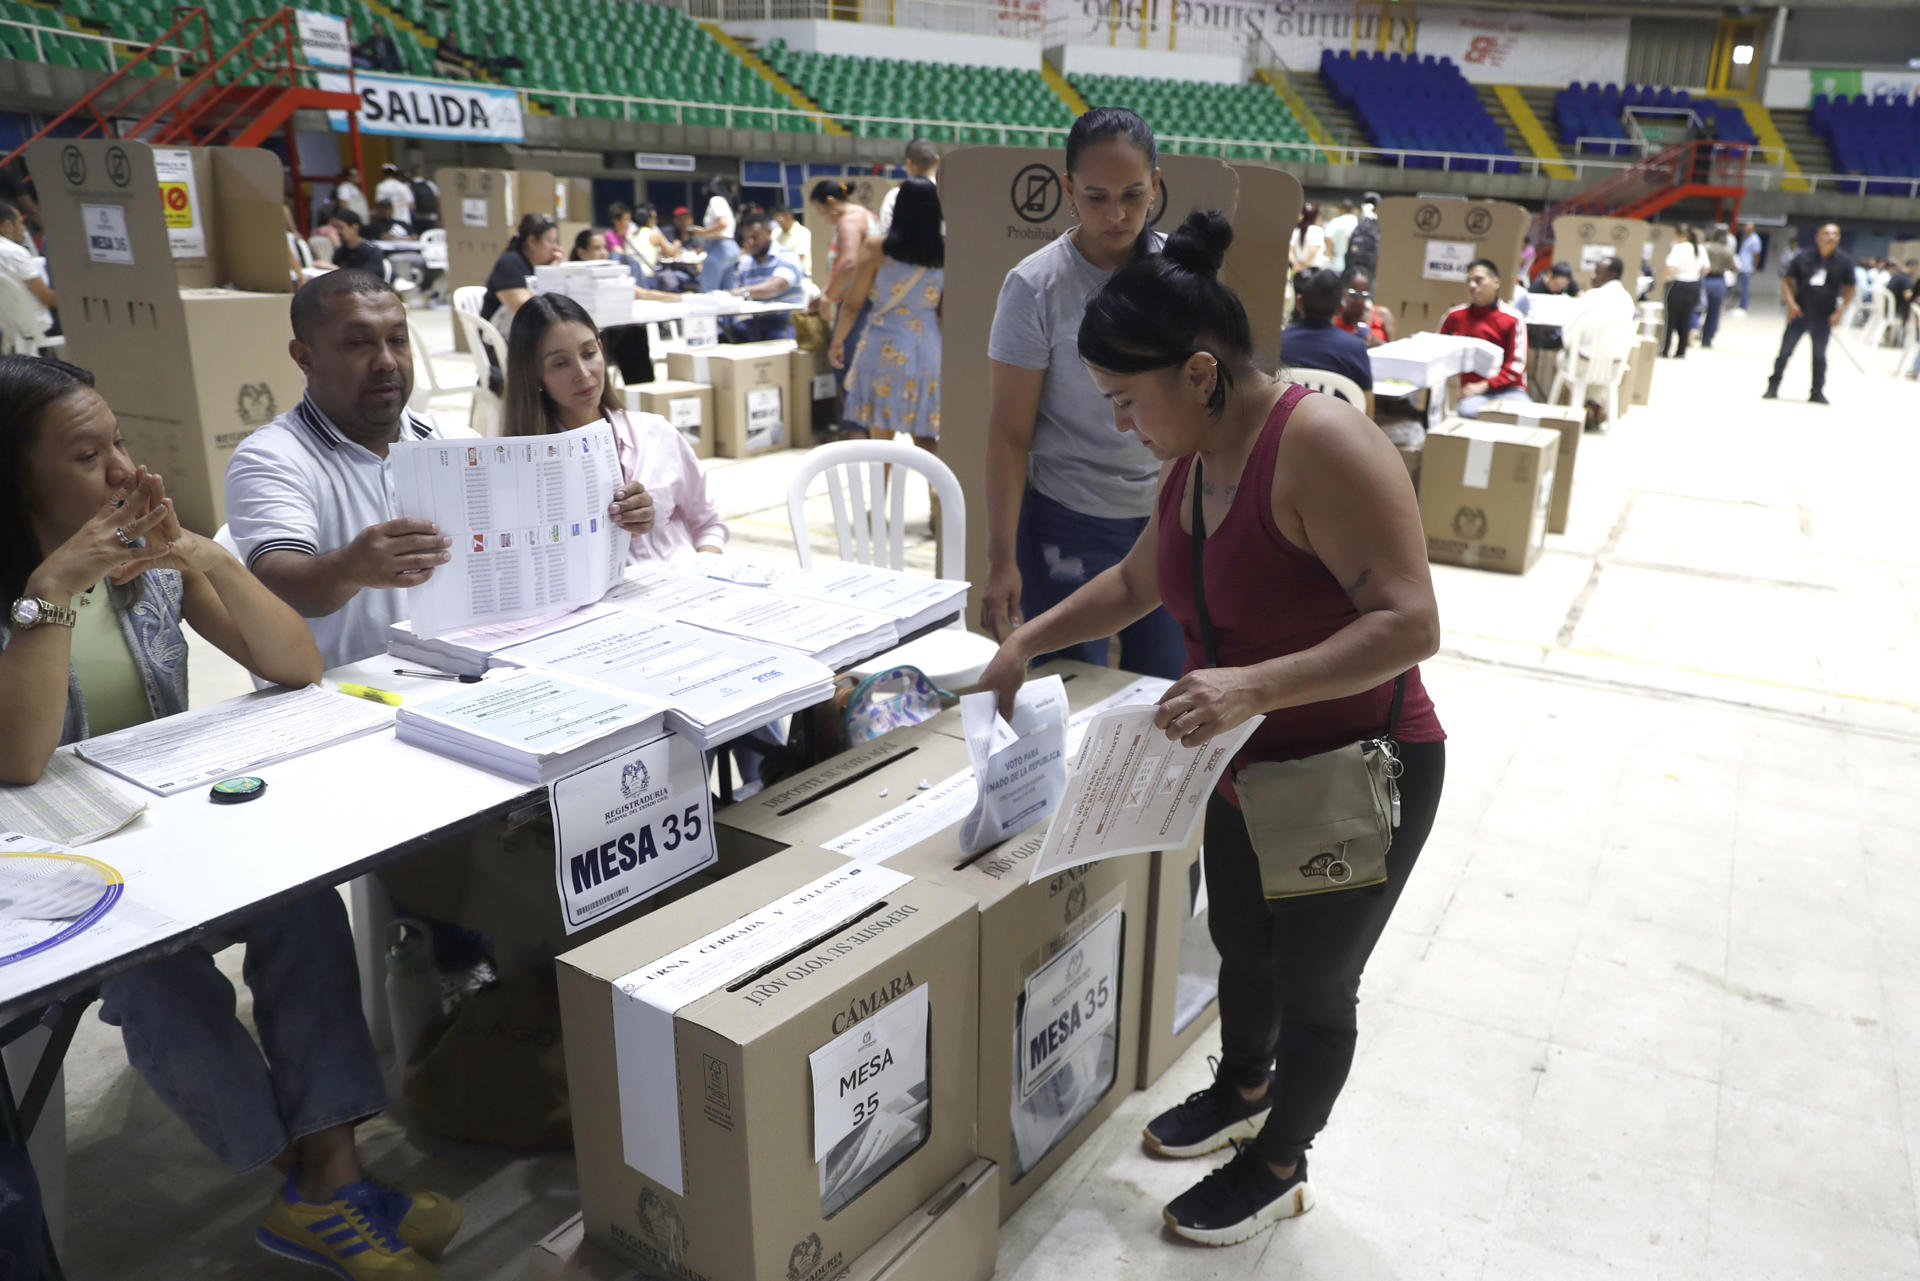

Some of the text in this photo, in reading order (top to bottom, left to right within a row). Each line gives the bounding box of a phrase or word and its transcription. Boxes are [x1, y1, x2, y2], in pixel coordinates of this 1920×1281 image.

[360, 88, 489, 129] SALIDA
[1007, 226, 1062, 240] Prohibid
[761, 773, 826, 809] DEPOSITE
[823, 765, 841, 780] SU
[839, 752, 870, 770] VOTO
[1005, 748, 1039, 772] VOTO PARA
[1010, 771, 1019, 783] DE
[1020, 767, 1028, 777] LA
[1077, 768, 1100, 817] VOTO PARA
[865, 811, 913, 836] CERRADA
[570, 803, 702, 895] MESA 35
[646, 959, 690, 980] URNA
[700, 921, 766, 954] CERRADA
[792, 876, 849, 906] SELLADA
[744, 904, 919, 1007] DEPOSITE SU VOTO AQUÍ
[832, 970, 915, 1035] CÁMARA
[1030, 998, 1082, 1072] MESA
[1084, 976, 1109, 1021] 35
[840, 1048, 894, 1098] MESA
[853, 1092, 880, 1126] 35
